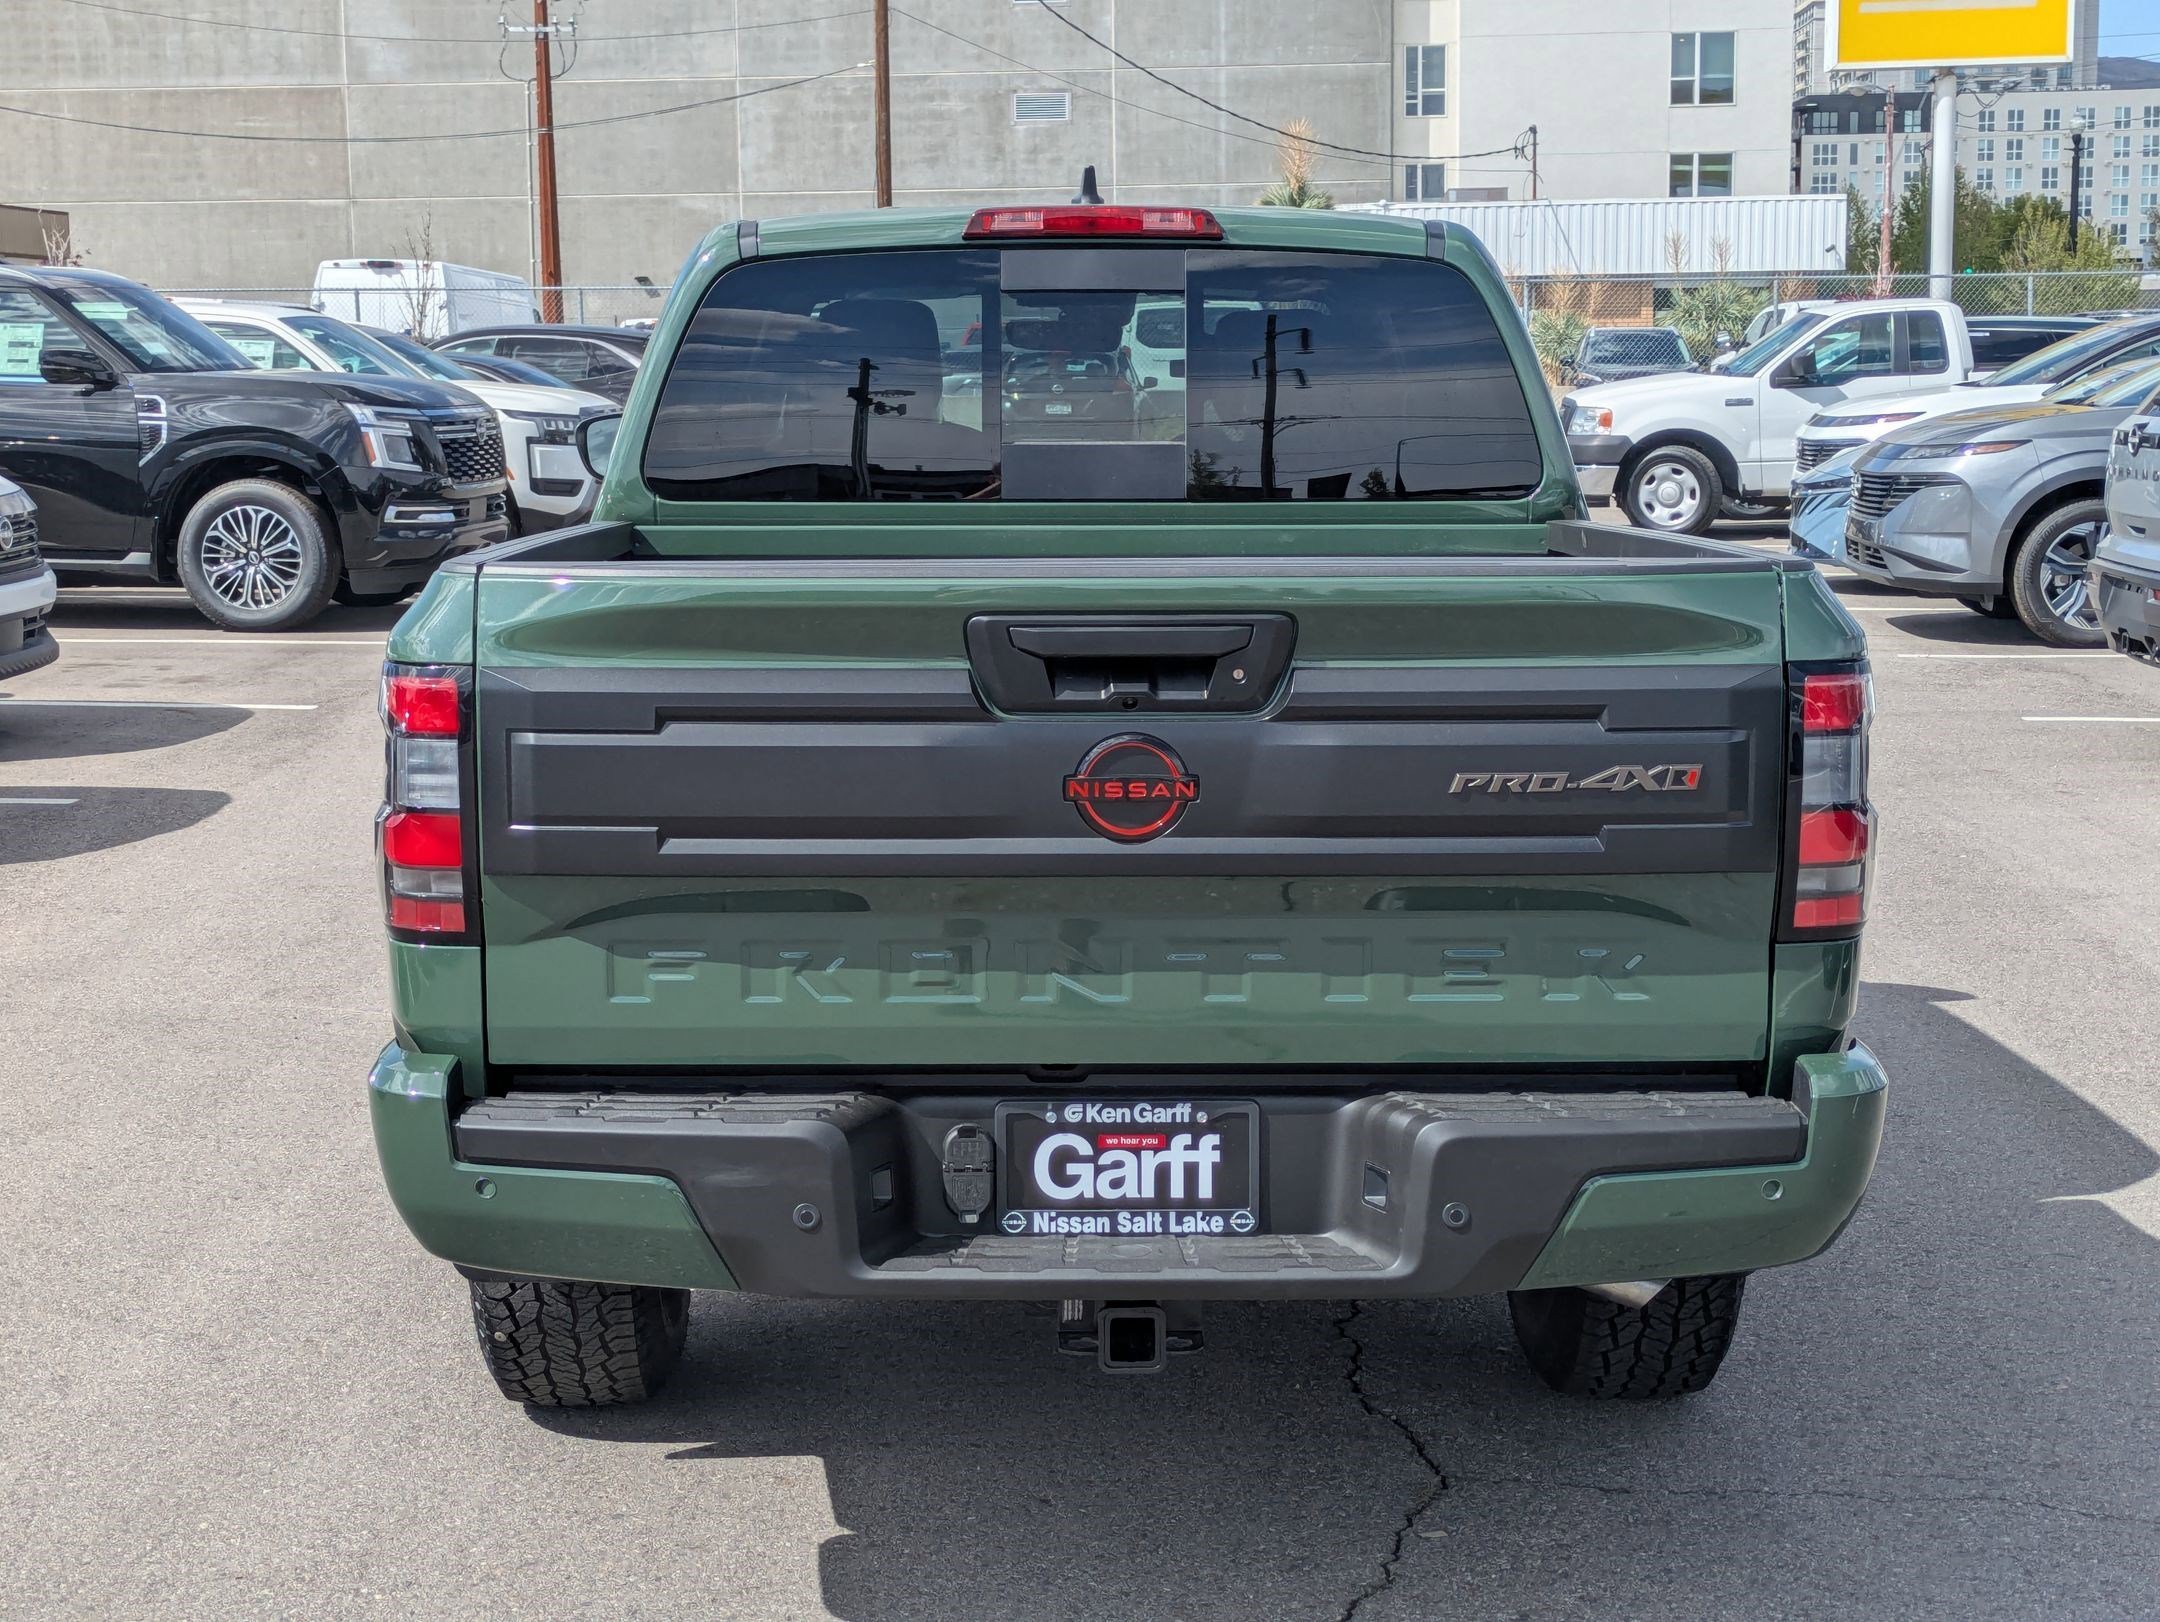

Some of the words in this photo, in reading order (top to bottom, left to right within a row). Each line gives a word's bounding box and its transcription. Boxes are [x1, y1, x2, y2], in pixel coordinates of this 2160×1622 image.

[1068, 780, 1195, 798] NISSAN
[607, 937, 1652, 1004] FRONTIER
[1086, 1104, 1131, 1123] Ken
[1133, 1103, 1192, 1123] Garff
[1120, 1137, 1140, 1145] hear
[1141, 1138, 1159, 1147] you
[1033, 1132, 1221, 1200] Garff
[1033, 1211, 1111, 1233] Nissan
[1117, 1211, 1163, 1233] Salt
[1169, 1211, 1225, 1233] Lake
